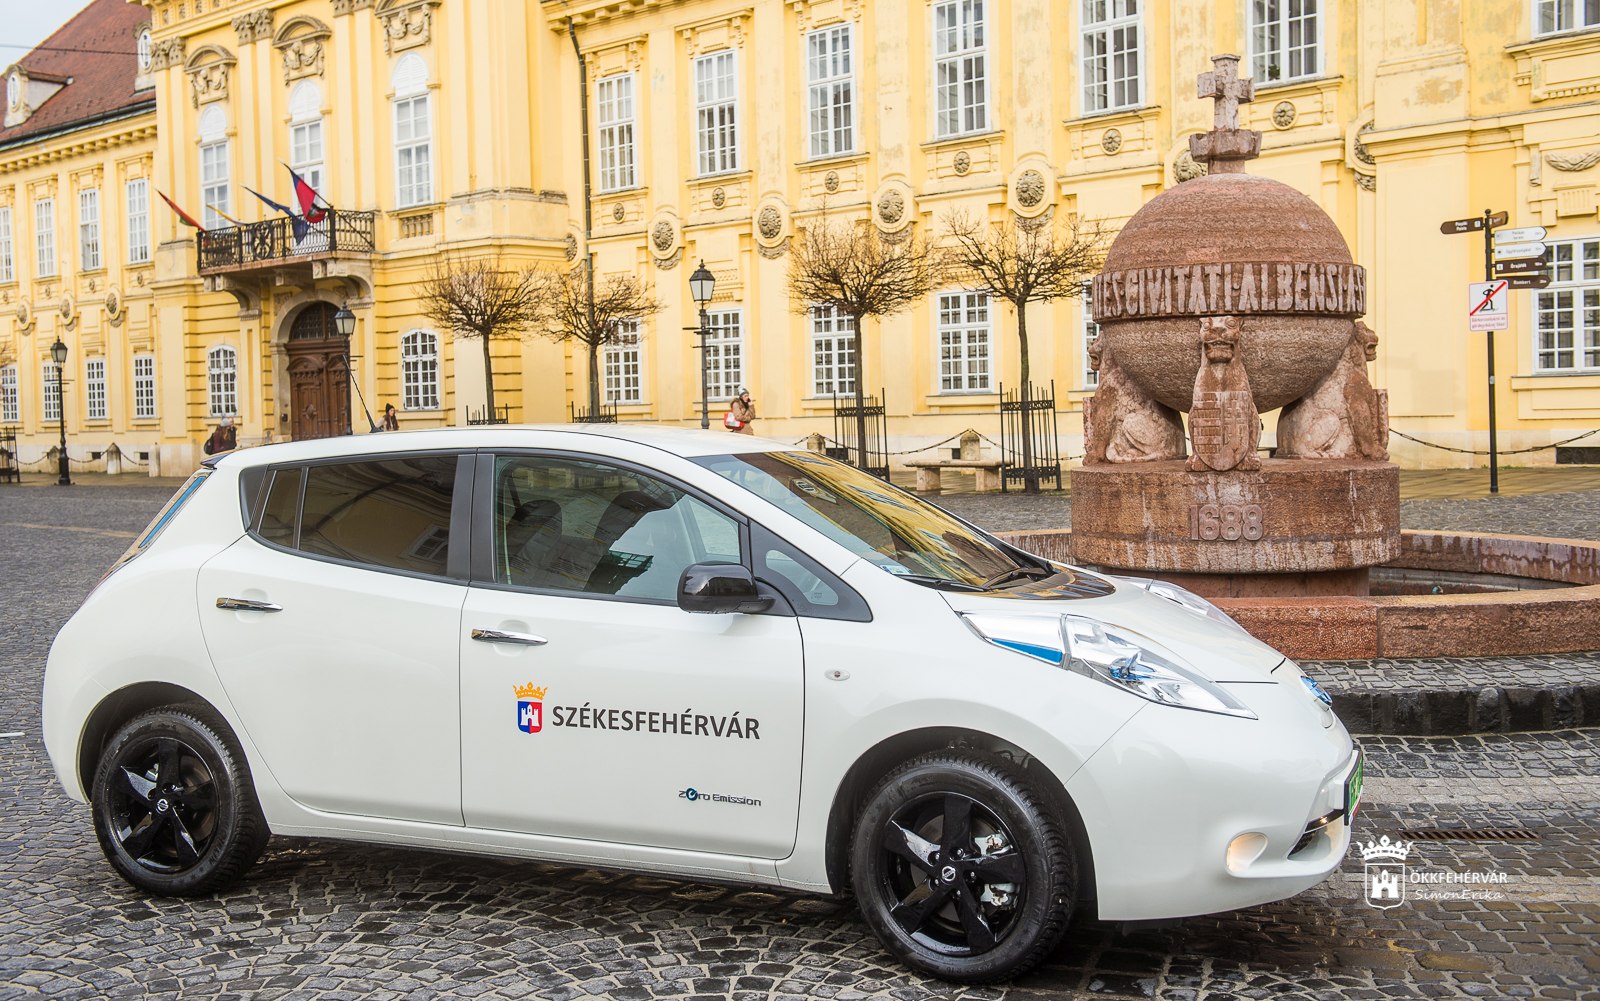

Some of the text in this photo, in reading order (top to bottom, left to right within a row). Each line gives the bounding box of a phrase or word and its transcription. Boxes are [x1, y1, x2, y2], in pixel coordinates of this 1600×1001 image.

[1190, 504, 1263, 541] 1688
[552, 702, 760, 740] SZÉKESFEHÉRVÁR
[712, 793, 762, 807] Emission
